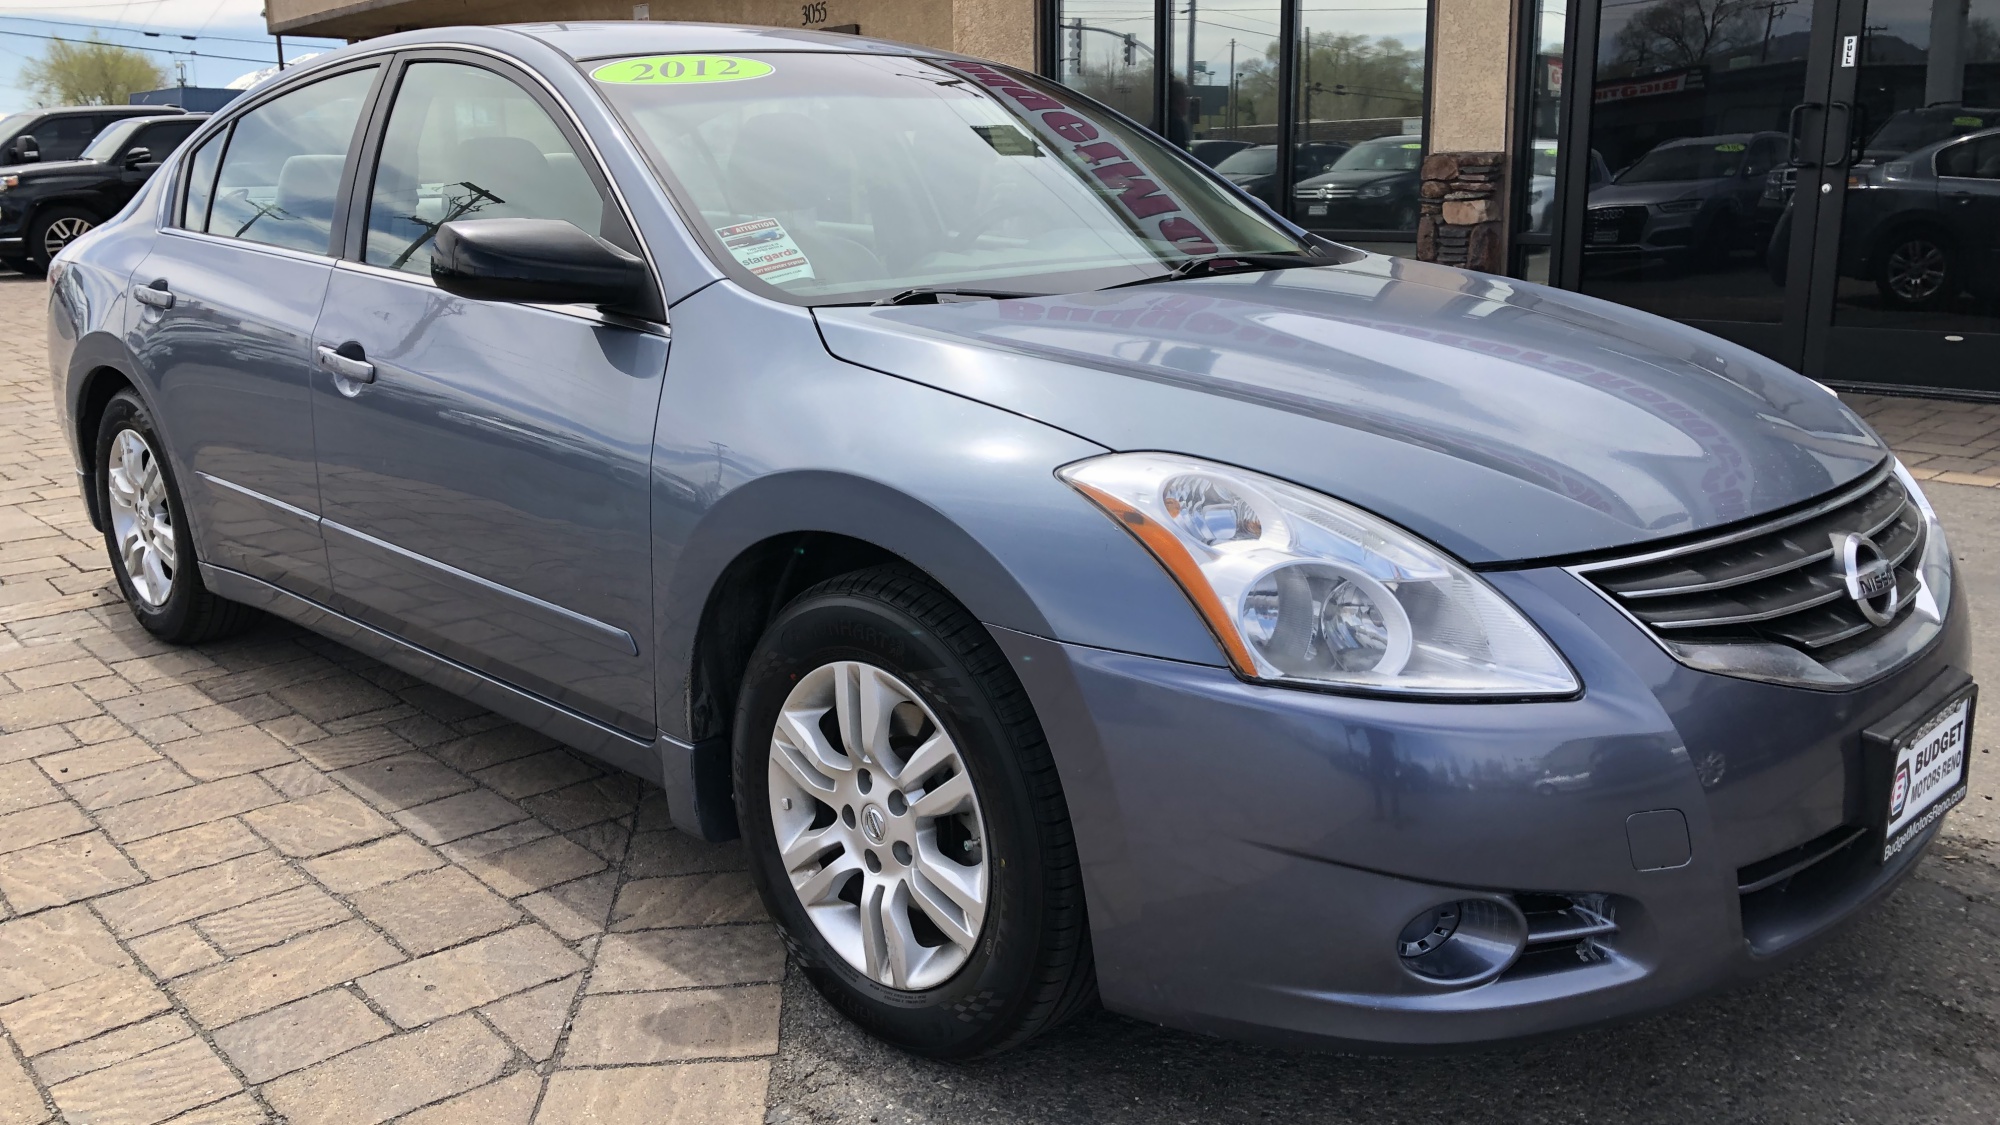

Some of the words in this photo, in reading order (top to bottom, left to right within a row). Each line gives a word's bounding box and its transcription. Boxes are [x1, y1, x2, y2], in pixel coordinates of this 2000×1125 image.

[801, 1, 827, 26] 3055
[1845, 38, 1854, 64] PULL
[629, 59, 741, 82] 2012
[735, 220, 775, 233] ATTENTION
[1859, 571, 1893, 594] NISS
[1914, 719, 1964, 775] BUDGET
[1910, 764, 1942, 804] MOTORS
[1941, 749, 1962, 779] RENO
[1883, 785, 1966, 862] BudgetMotorsReno.com
